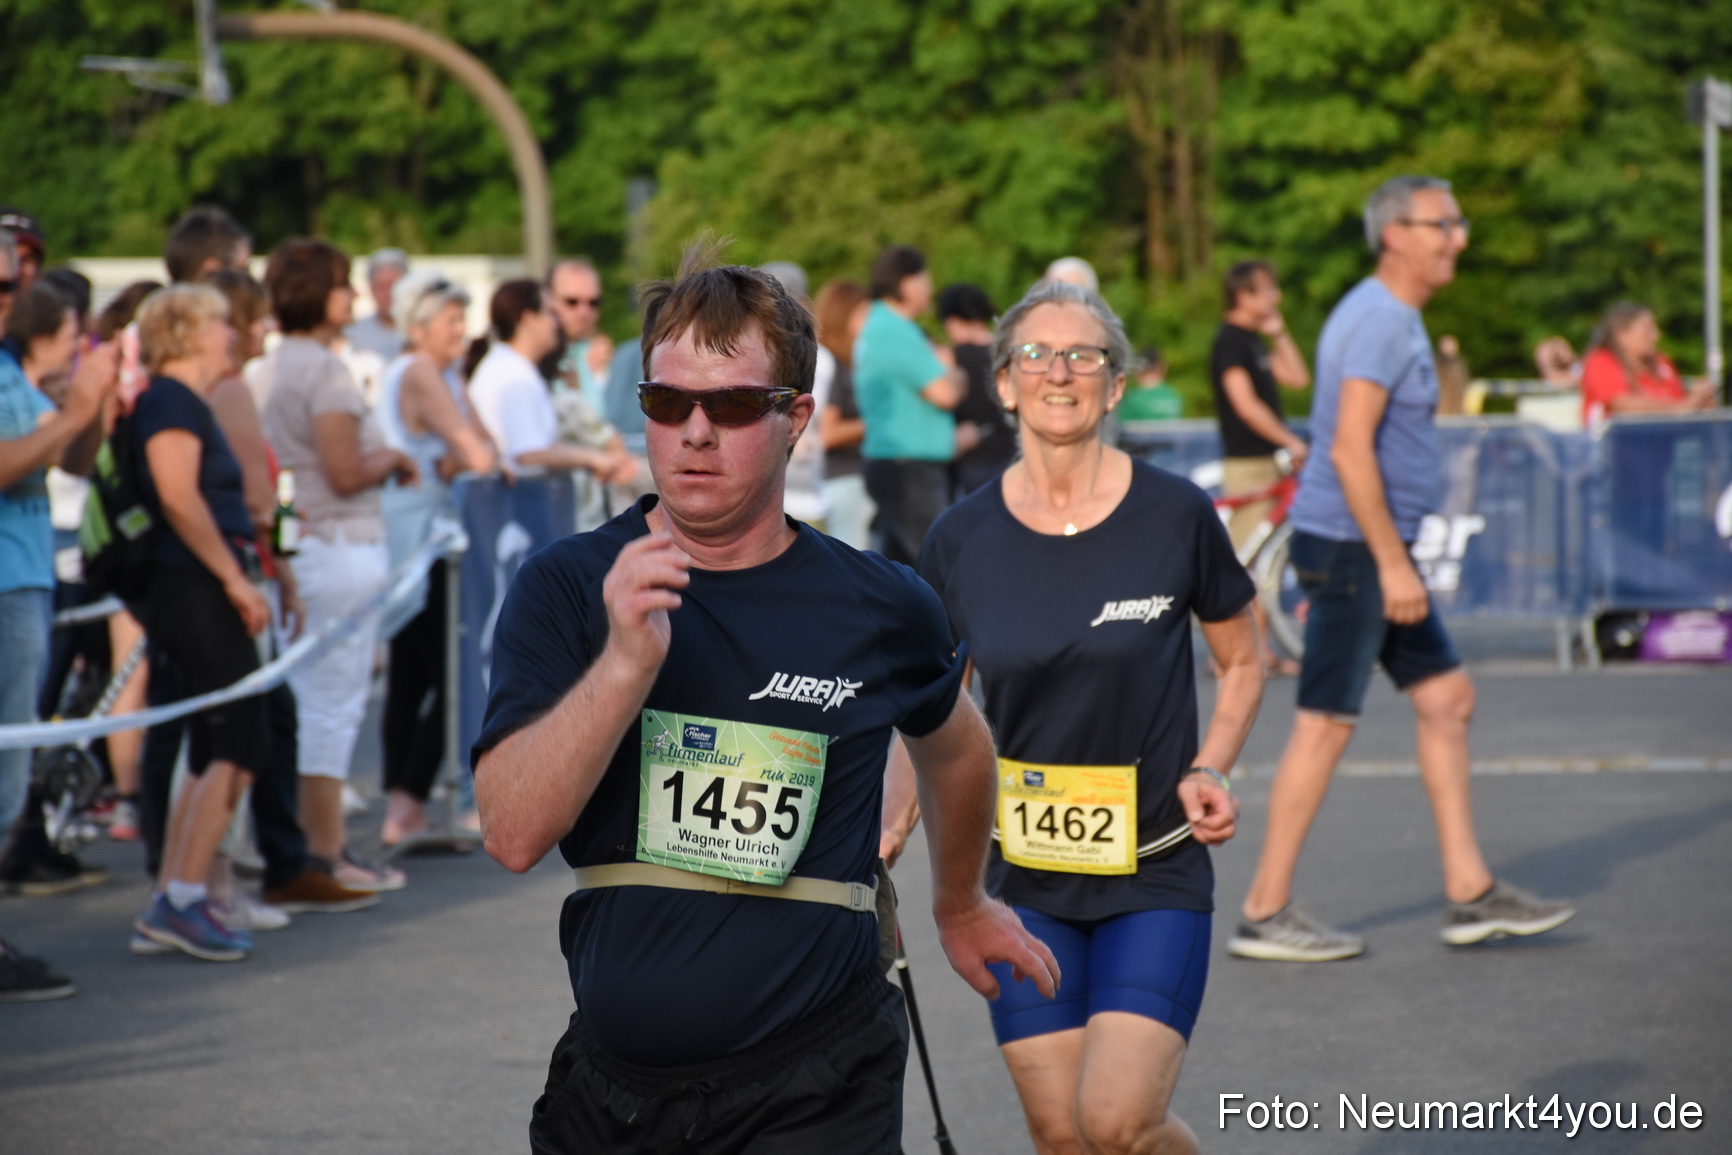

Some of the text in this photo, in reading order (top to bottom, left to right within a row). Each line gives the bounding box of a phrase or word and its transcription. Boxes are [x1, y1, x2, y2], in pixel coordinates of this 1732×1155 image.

[1090, 598, 1152, 627] JURA
[748, 671, 836, 701] JURA
[769, 690, 824, 705] SPORT SERVICE
[668, 743, 745, 767] firmenlauf
[760, 769, 816, 787] run 2019
[663, 770, 804, 840] 1455
[1014, 802, 1113, 842] 1462
[666, 842, 718, 860] Lebenshilfe
[720, 852, 769, 867] Neumarkt
[771, 861, 779, 869] e.
[678, 828, 780, 856] Wagner Ulrich
[1027, 842, 1102, 855] Wittmann Gabi
